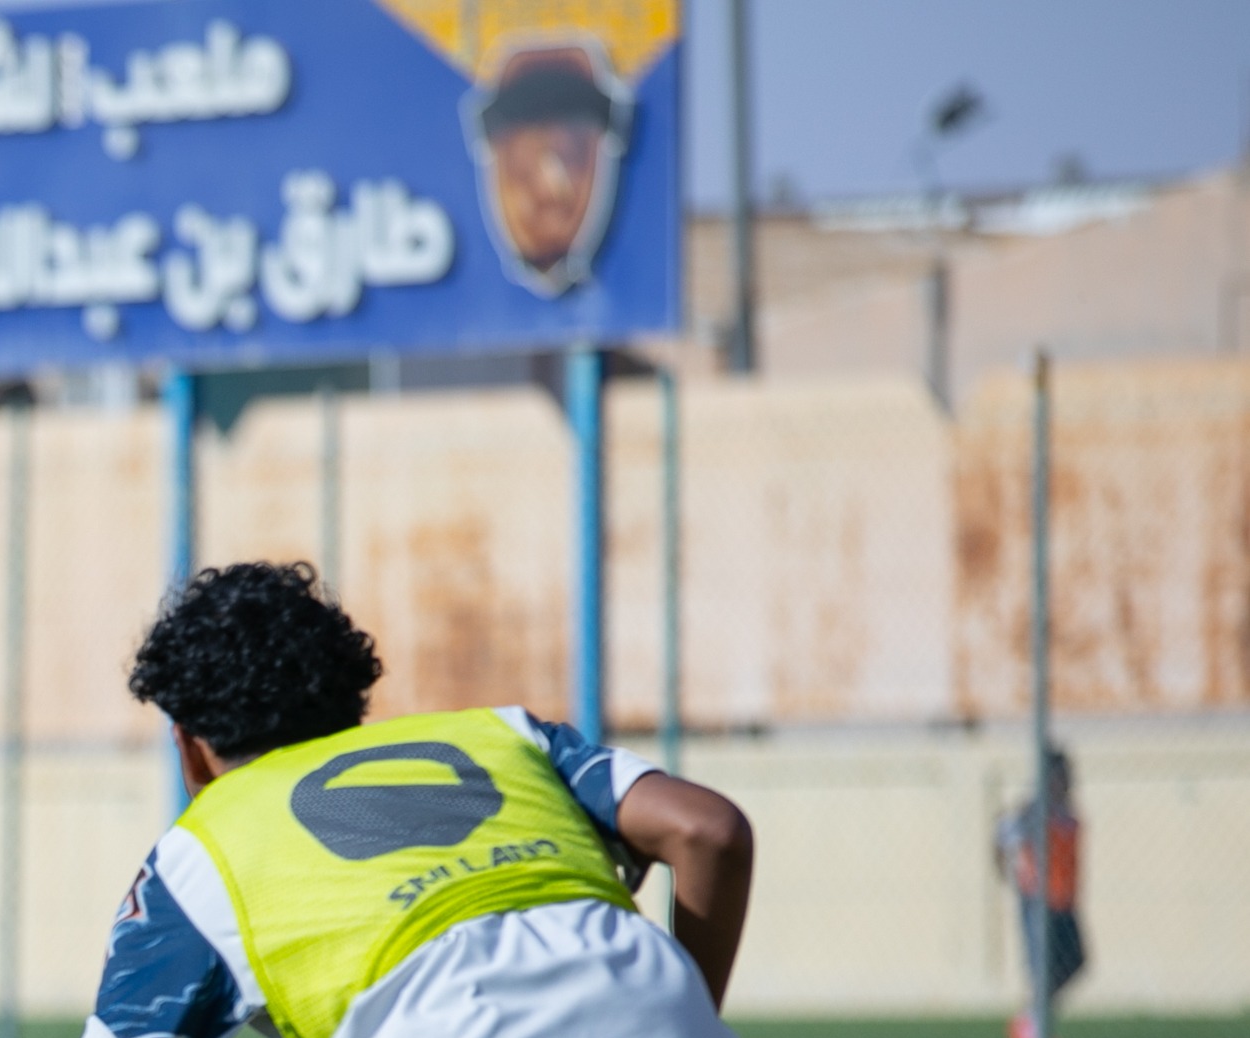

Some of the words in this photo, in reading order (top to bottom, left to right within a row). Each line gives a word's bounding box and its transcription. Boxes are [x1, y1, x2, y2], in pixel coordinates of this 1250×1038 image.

[89, 18, 291, 162] ملعب
[160, 201, 259, 335] بن
[259, 166, 456, 324] طارق
